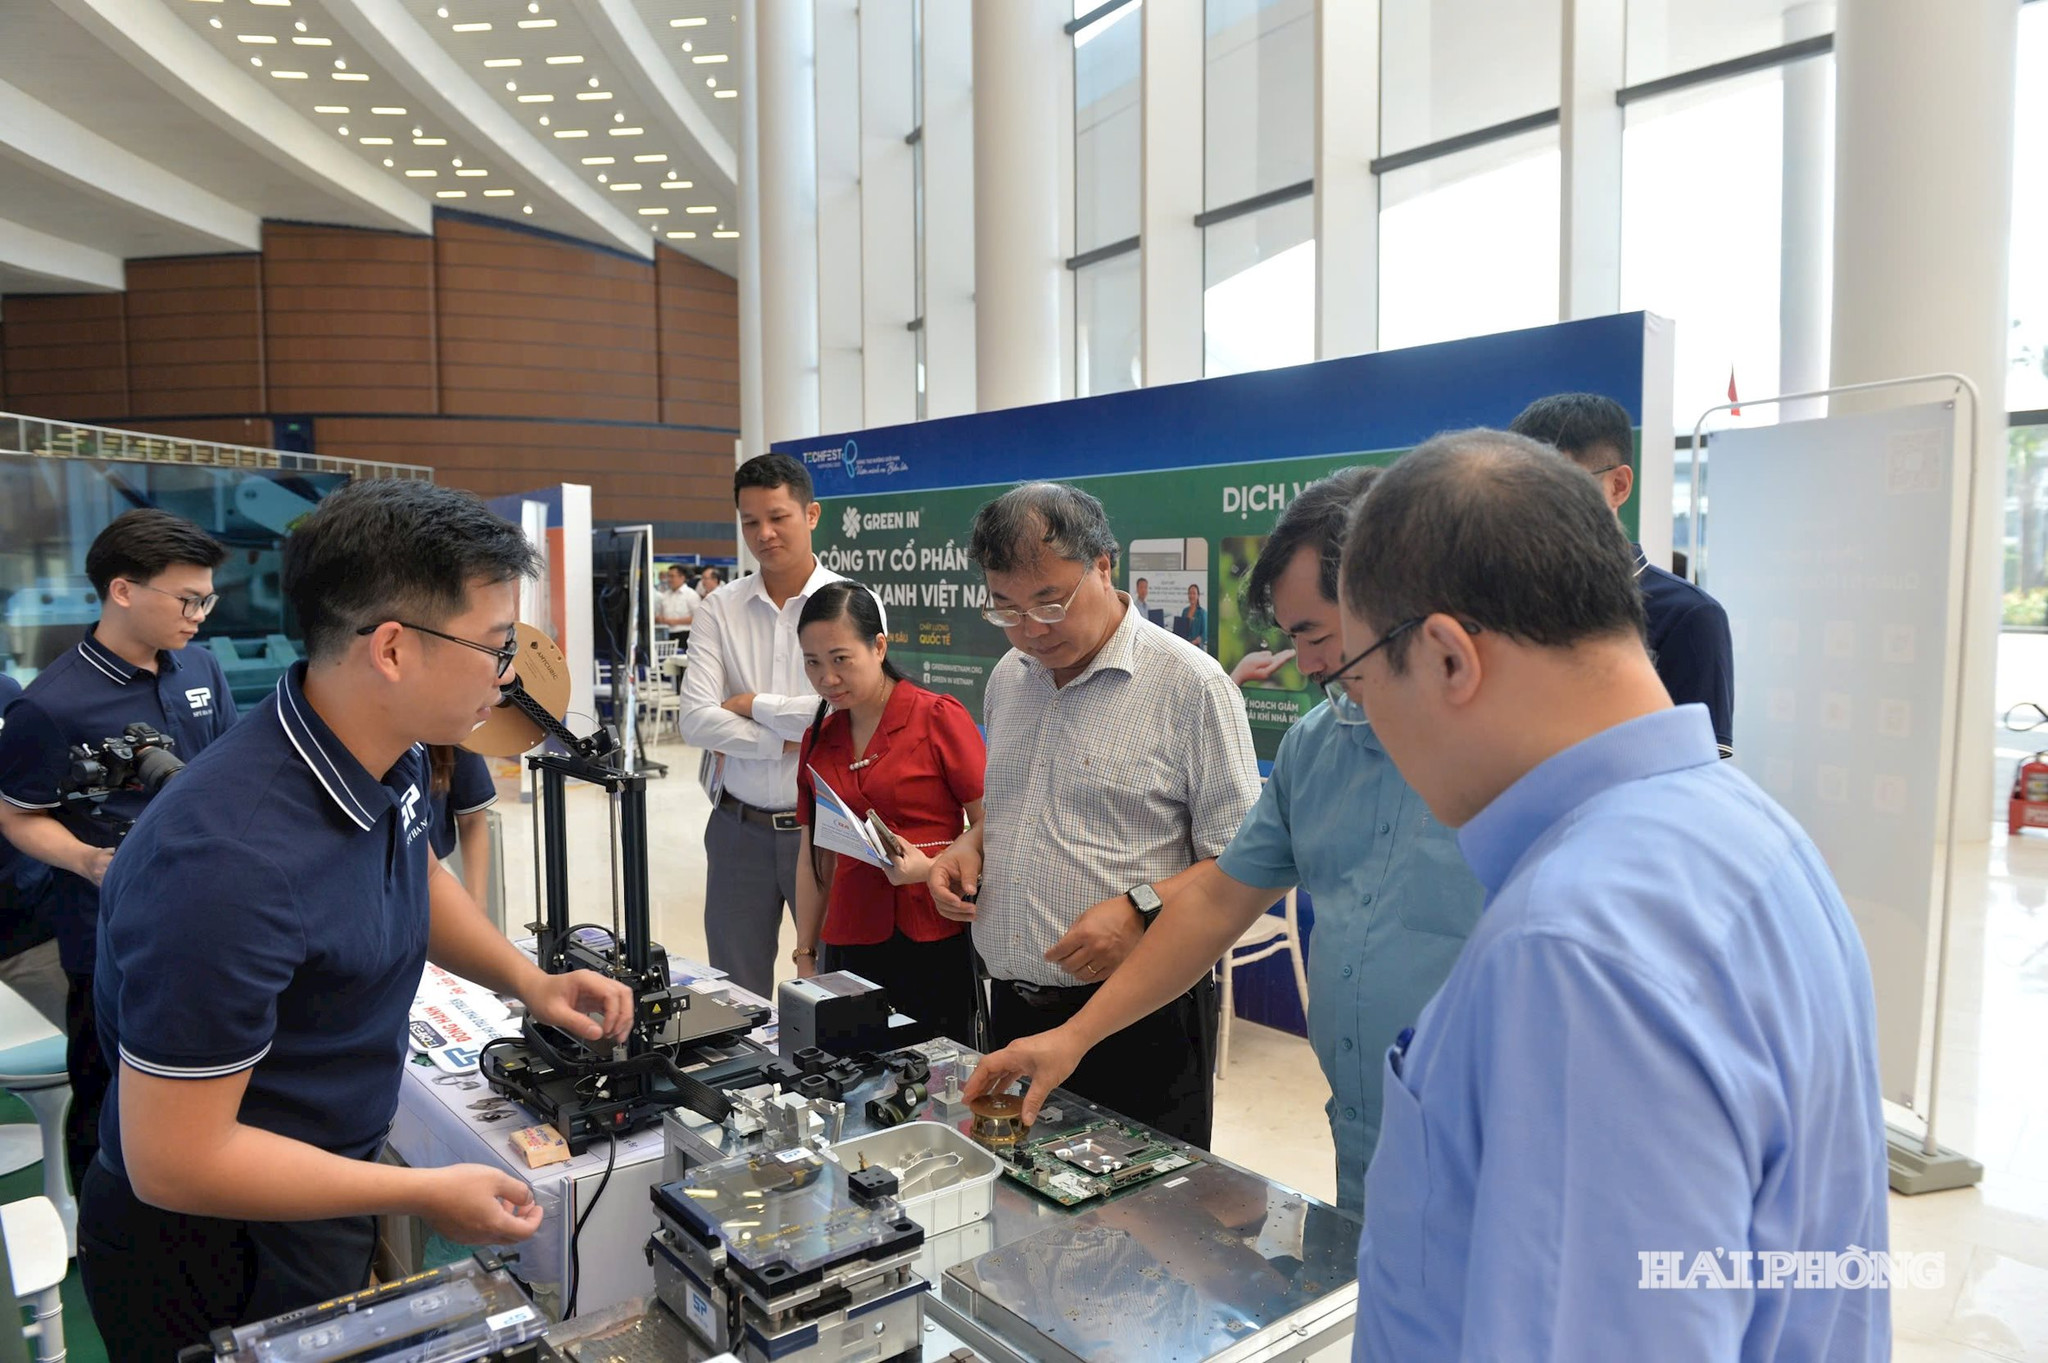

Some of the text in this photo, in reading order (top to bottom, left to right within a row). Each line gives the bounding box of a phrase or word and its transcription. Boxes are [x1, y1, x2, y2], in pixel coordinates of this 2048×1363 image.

[803, 448, 843, 463] TECHFEST
[1223, 483, 1285, 520] DỊCH
[863, 511, 919, 530] GREEN IN
[819, 538, 969, 571] CÔNG TY CỔ PHẦN
[873, 584, 917, 606] XANH
[921, 579, 959, 614] VIỆT
[1249, 700, 1277, 711] HOẠCH
[1278, 700, 1299, 712] GIẢM
